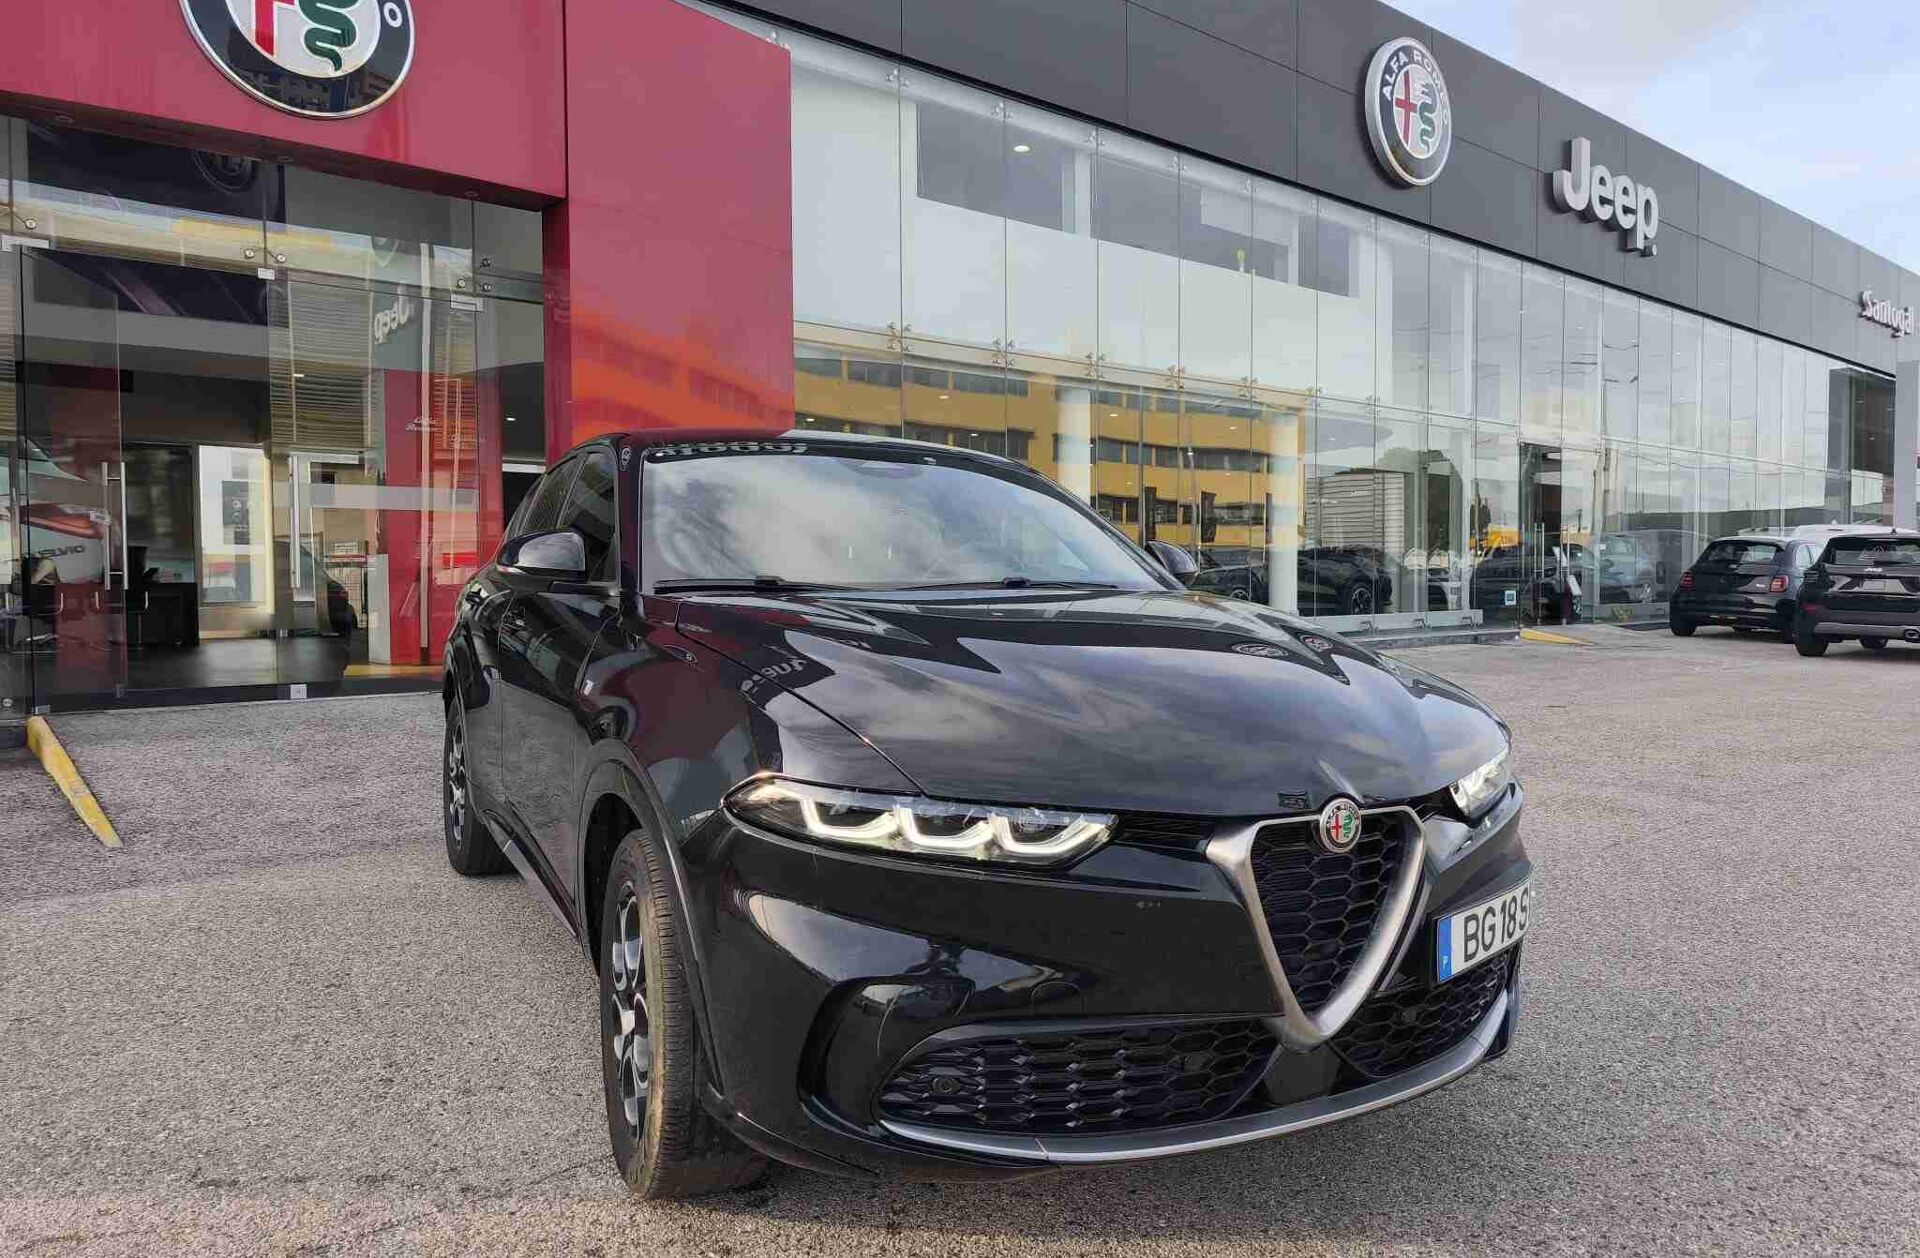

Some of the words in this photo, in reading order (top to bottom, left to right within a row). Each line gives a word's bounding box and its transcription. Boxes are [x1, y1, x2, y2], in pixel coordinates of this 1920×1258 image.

[1382, 50, 1409, 101] ALFA
[1413, 50, 1448, 126] ROMEO
[1553, 136, 1659, 252] Jeep
